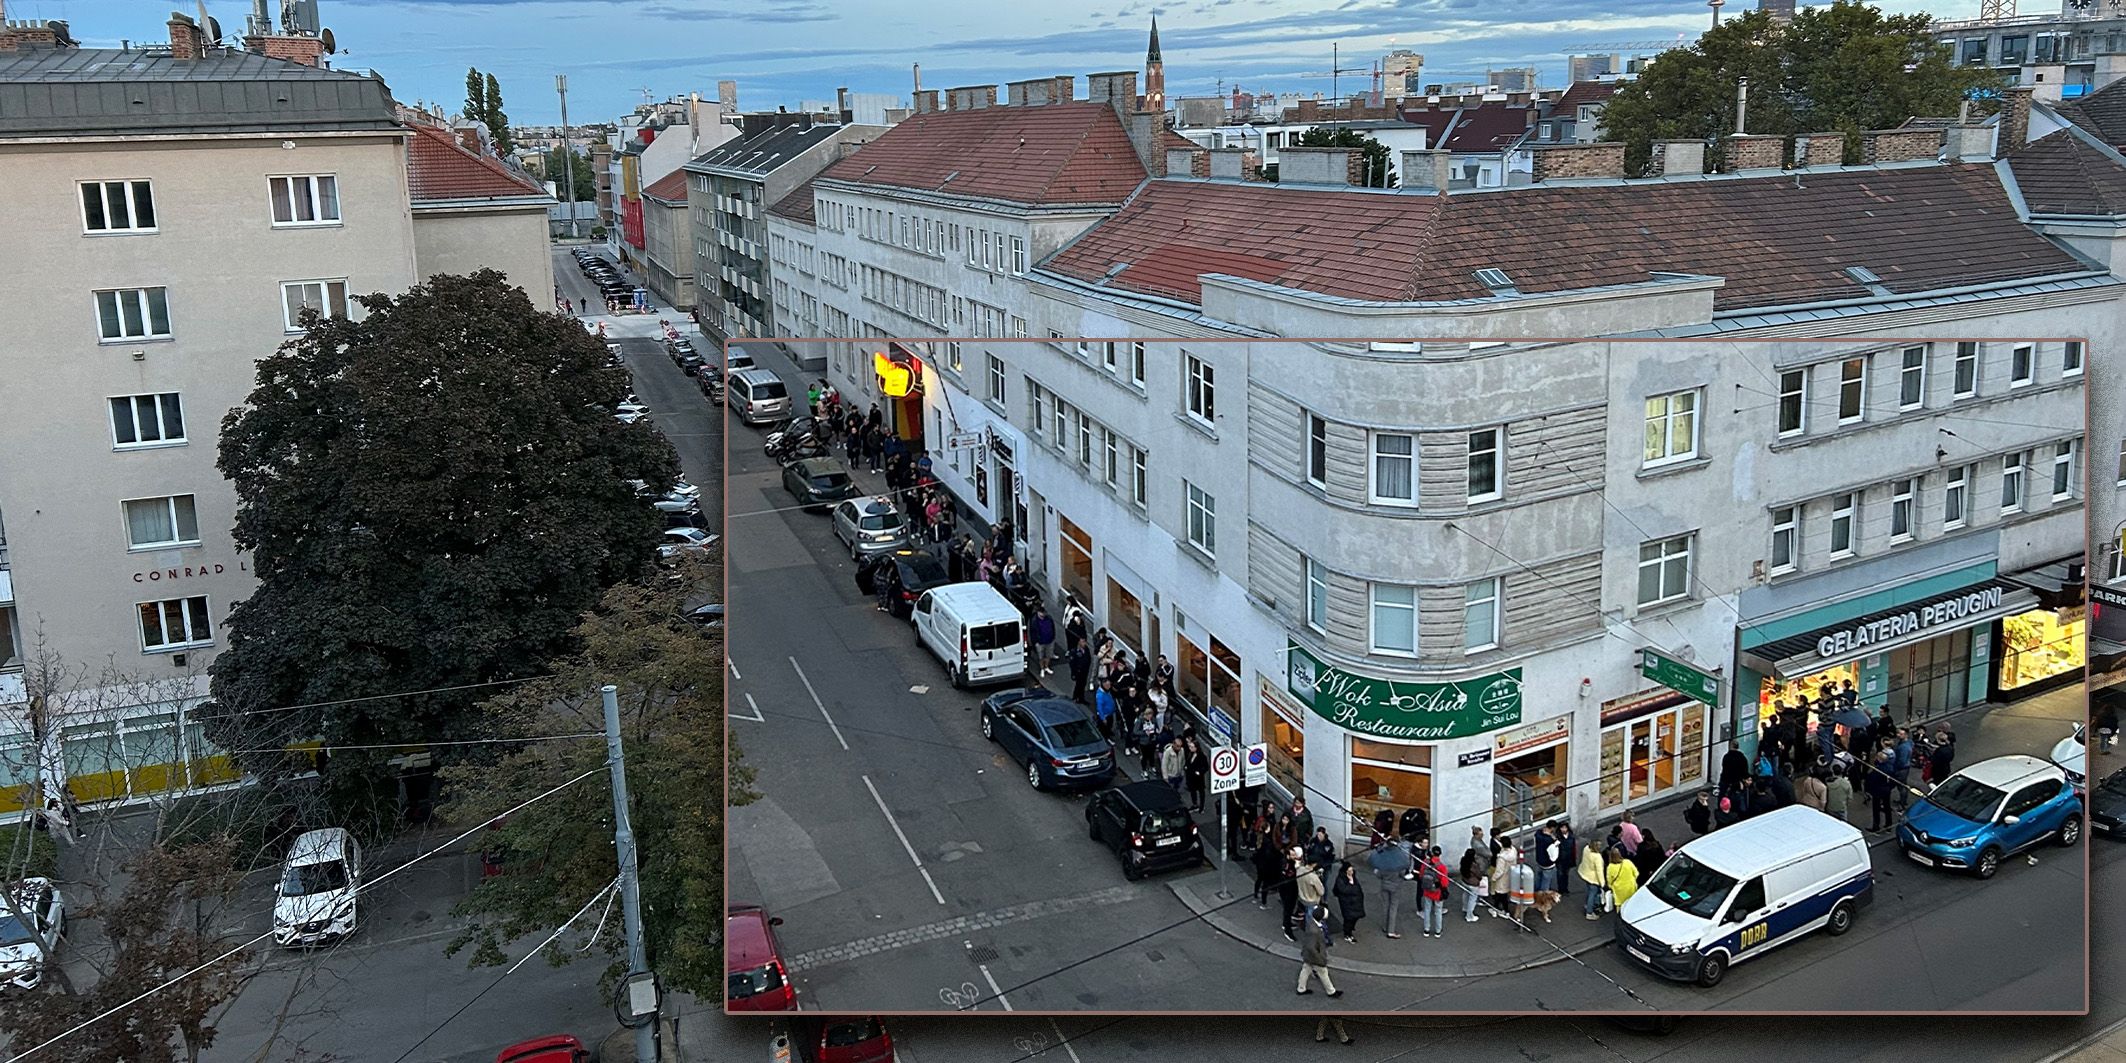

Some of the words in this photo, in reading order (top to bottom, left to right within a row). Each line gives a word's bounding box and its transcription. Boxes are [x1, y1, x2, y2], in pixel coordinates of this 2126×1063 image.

[133, 564, 224, 582] CONRAD
[1817, 611, 1919, 658] GELATERIA
[1920, 586, 2002, 628] PERUGINI
[1321, 668, 1372, 707] Wok
[1397, 686, 1467, 713] Asia
[1333, 701, 1456, 738] Restaurant
[1480, 718, 1492, 728] Jin
[1506, 712, 1520, 721] Lou
[1219, 756, 1232, 770] 30
[1213, 778, 1237, 791] Zone
